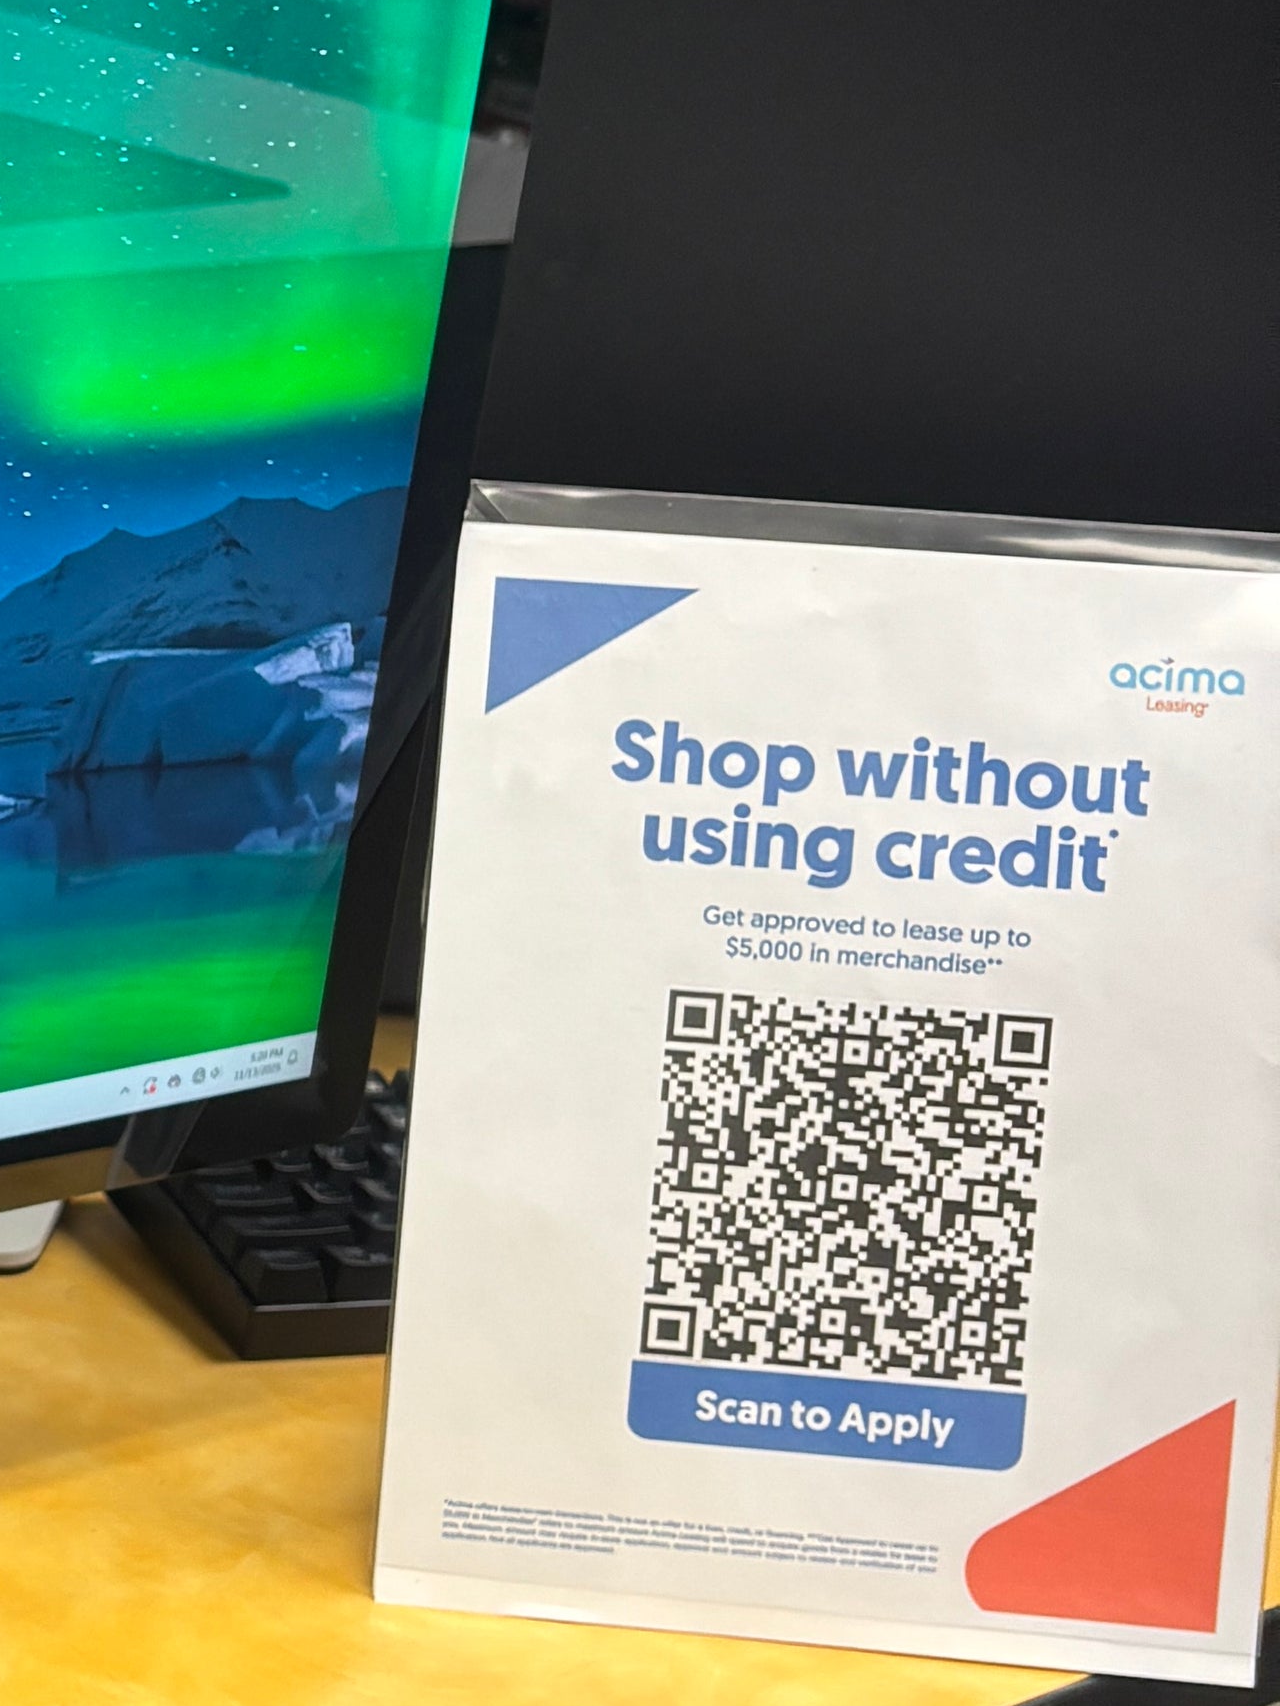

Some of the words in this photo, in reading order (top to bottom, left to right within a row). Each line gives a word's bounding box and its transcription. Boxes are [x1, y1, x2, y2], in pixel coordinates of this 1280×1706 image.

[1109, 657, 1246, 696] acima
[1145, 695, 1207, 718] Leasing
[610, 718, 816, 807] Shop
[837, 736, 1151, 817] without
[642, 803, 855, 889] using
[702, 904, 744, 927] Get
[750, 911, 866, 936] approved
[872, 919, 896, 939] to
[903, 919, 964, 943] lease
[970, 928, 1001, 948] up
[1007, 928, 1032, 948] to
[725, 936, 804, 962] $5,000
[810, 942, 831, 965] in
[695, 1389, 783, 1427] Scan
[790, 1400, 832, 1431] to
[838, 1402, 955, 1449] Apply
